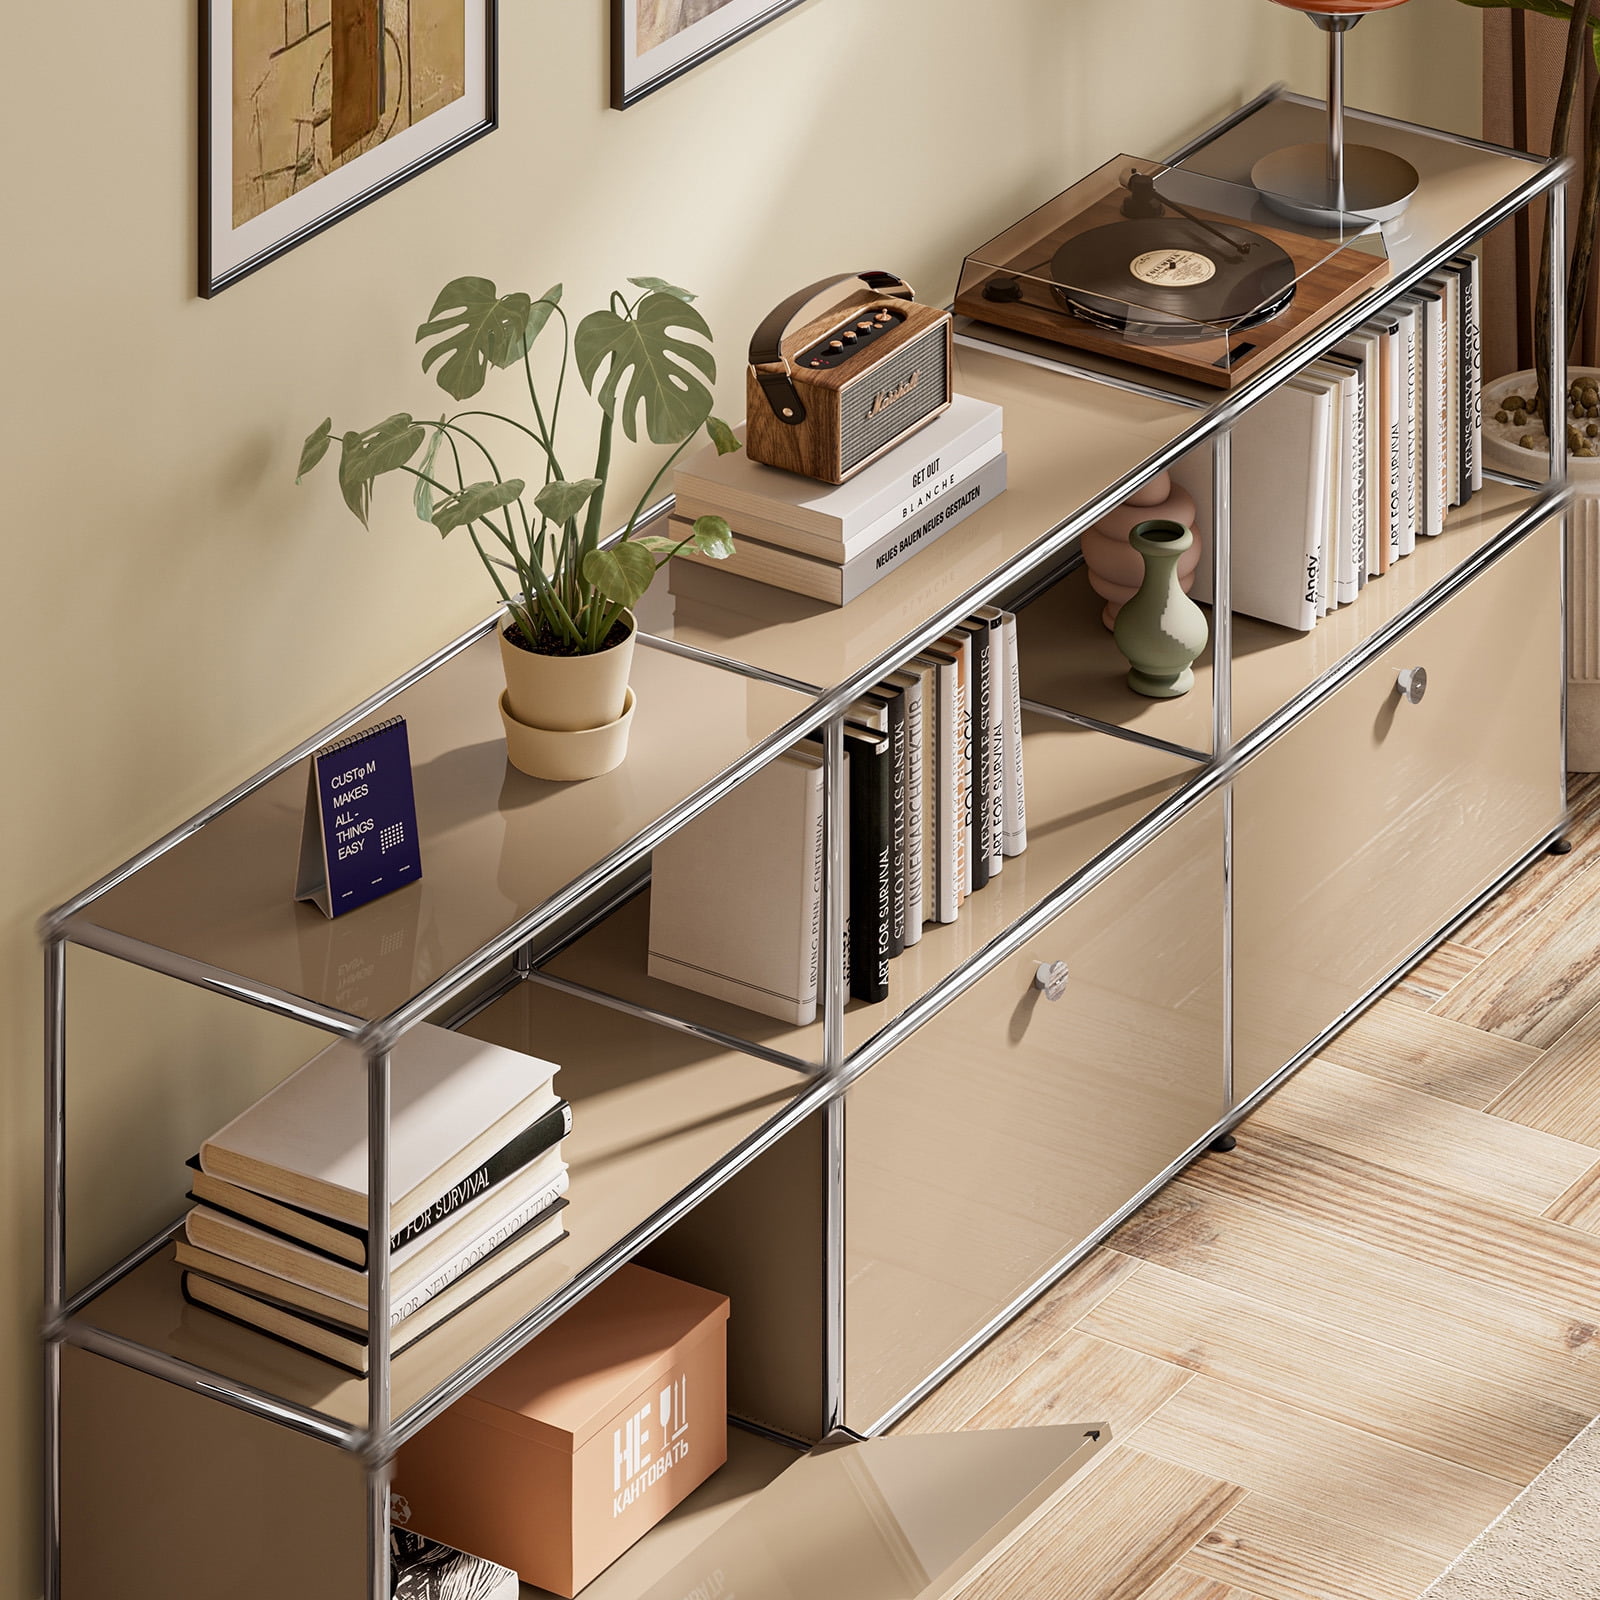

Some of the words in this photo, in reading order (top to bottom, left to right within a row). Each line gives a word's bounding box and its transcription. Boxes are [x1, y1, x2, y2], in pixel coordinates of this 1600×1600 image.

[867, 369, 921, 420] Marshall
[902, 473, 955, 518] BLANCHE
[912, 469, 926, 488] GET
[926, 457, 940, 479] OUT
[875, 544, 898, 570] NEUES
[899, 527, 922, 553] BAUEN
[922, 511, 944, 535] NEUES
[945, 484, 981, 519] GESTALTEN
[1305, 554, 1319, 603] Andy
[980, 646, 990, 729] STORIES
[894, 720, 905, 784] MEN'S
[980, 735, 990, 795] STYLE
[993, 720, 1002, 790] SURVIVAL
[333, 784, 369, 808] MAKES
[894, 788, 905, 852] STYLE
[909, 697, 922, 907] INNENARCHITEKTUR
[993, 796, 1002, 826] FOR
[335, 818, 375, 844] THINGS
[338, 838, 366, 860] EASY
[980, 799, 990, 862] MEN'S
[993, 831, 1002, 856] ART
[878, 845, 889, 913] SURVIVAL
[894, 858, 905, 939] STORIES
[878, 916, 889, 952] FOR
[878, 957, 889, 986] ART
[406, 1207, 431, 1240] FOR
[435, 1167, 490, 1220] SURVIVAL
[425, 1270, 451, 1301] NEW
[454, 1246, 486, 1277] LOOK
[488, 1184, 560, 1252] REVOLUTION
[613, 1402, 651, 1491] НЕ
[613, 1438, 689, 1518] КАНТОВАТЬ
